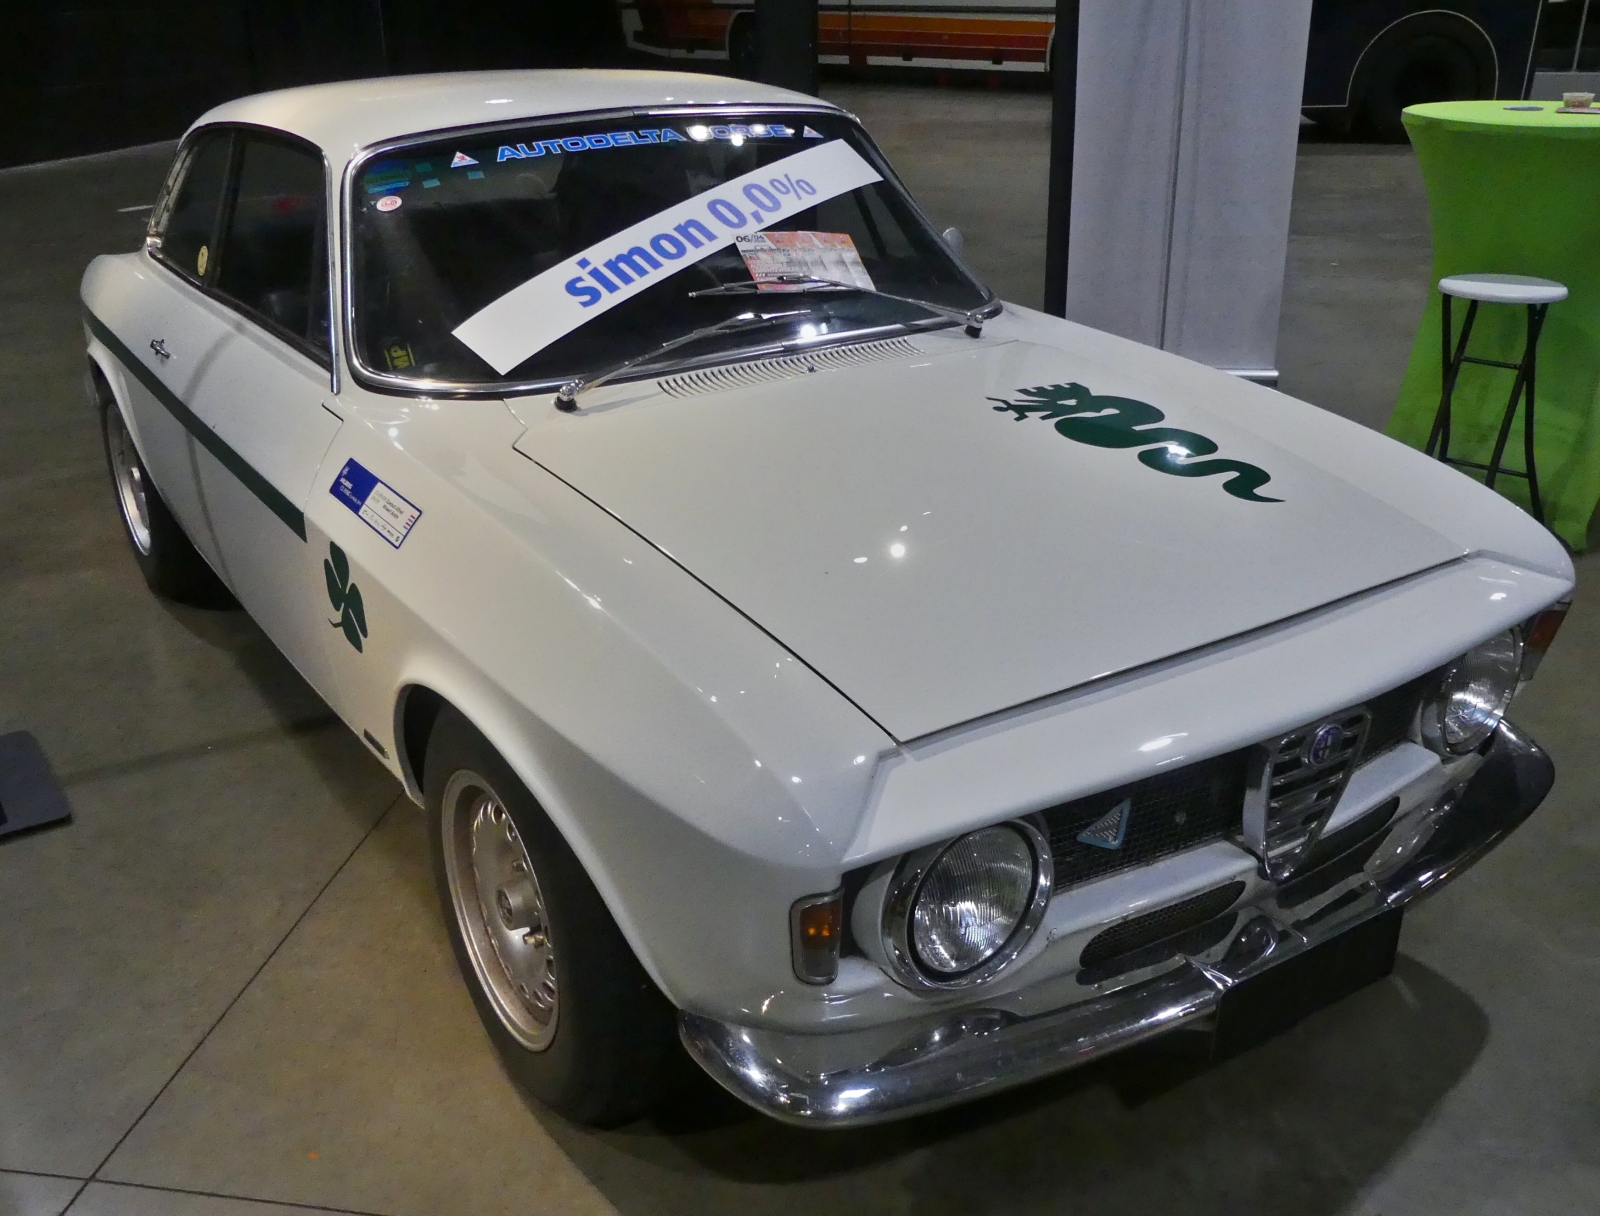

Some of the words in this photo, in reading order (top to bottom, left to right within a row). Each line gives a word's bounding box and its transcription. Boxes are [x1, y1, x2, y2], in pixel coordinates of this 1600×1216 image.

[496, 128, 687, 162] AUTODELTA
[563, 217, 719, 308] simon
[706, 173, 818, 230] 0,0%
